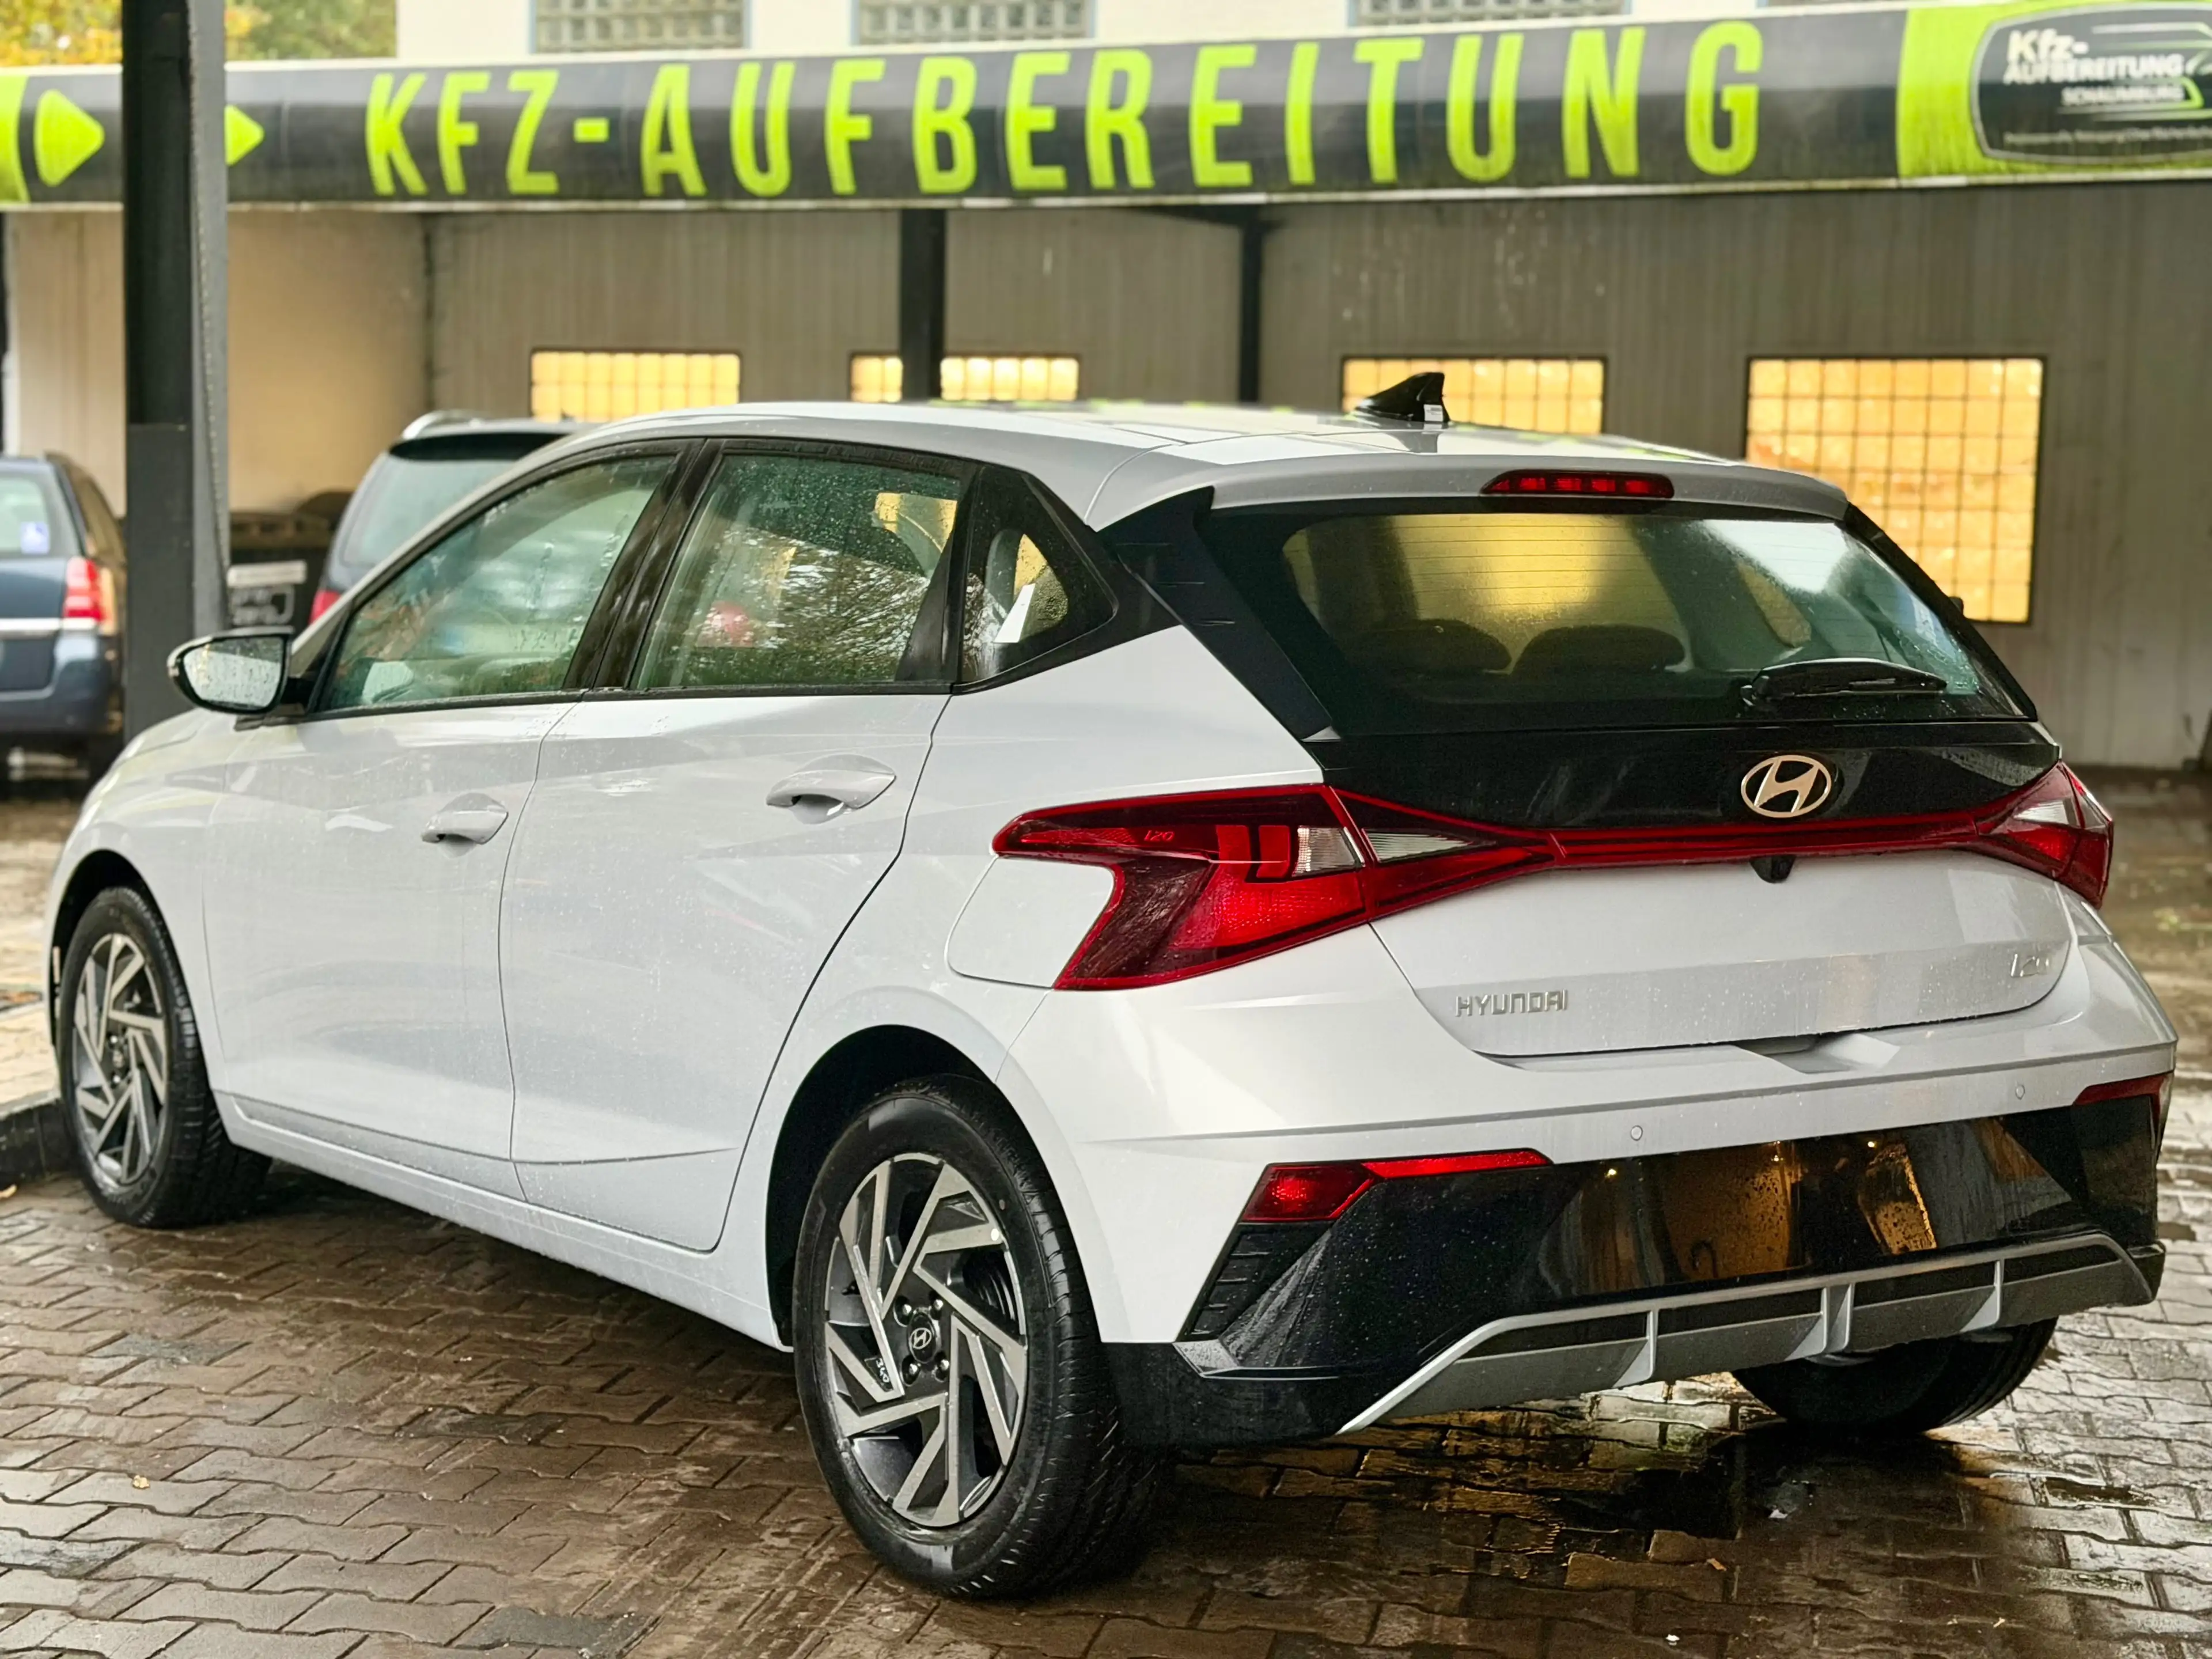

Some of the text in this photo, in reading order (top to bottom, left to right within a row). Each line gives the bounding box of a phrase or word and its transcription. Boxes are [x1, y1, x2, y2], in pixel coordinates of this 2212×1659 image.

[2008, 28, 2089, 62] Kfz-
[364, 25, 1762, 197] KFZ-AUFBEREITUNG
[1455, 989, 1567, 1017] HYUNDAI
